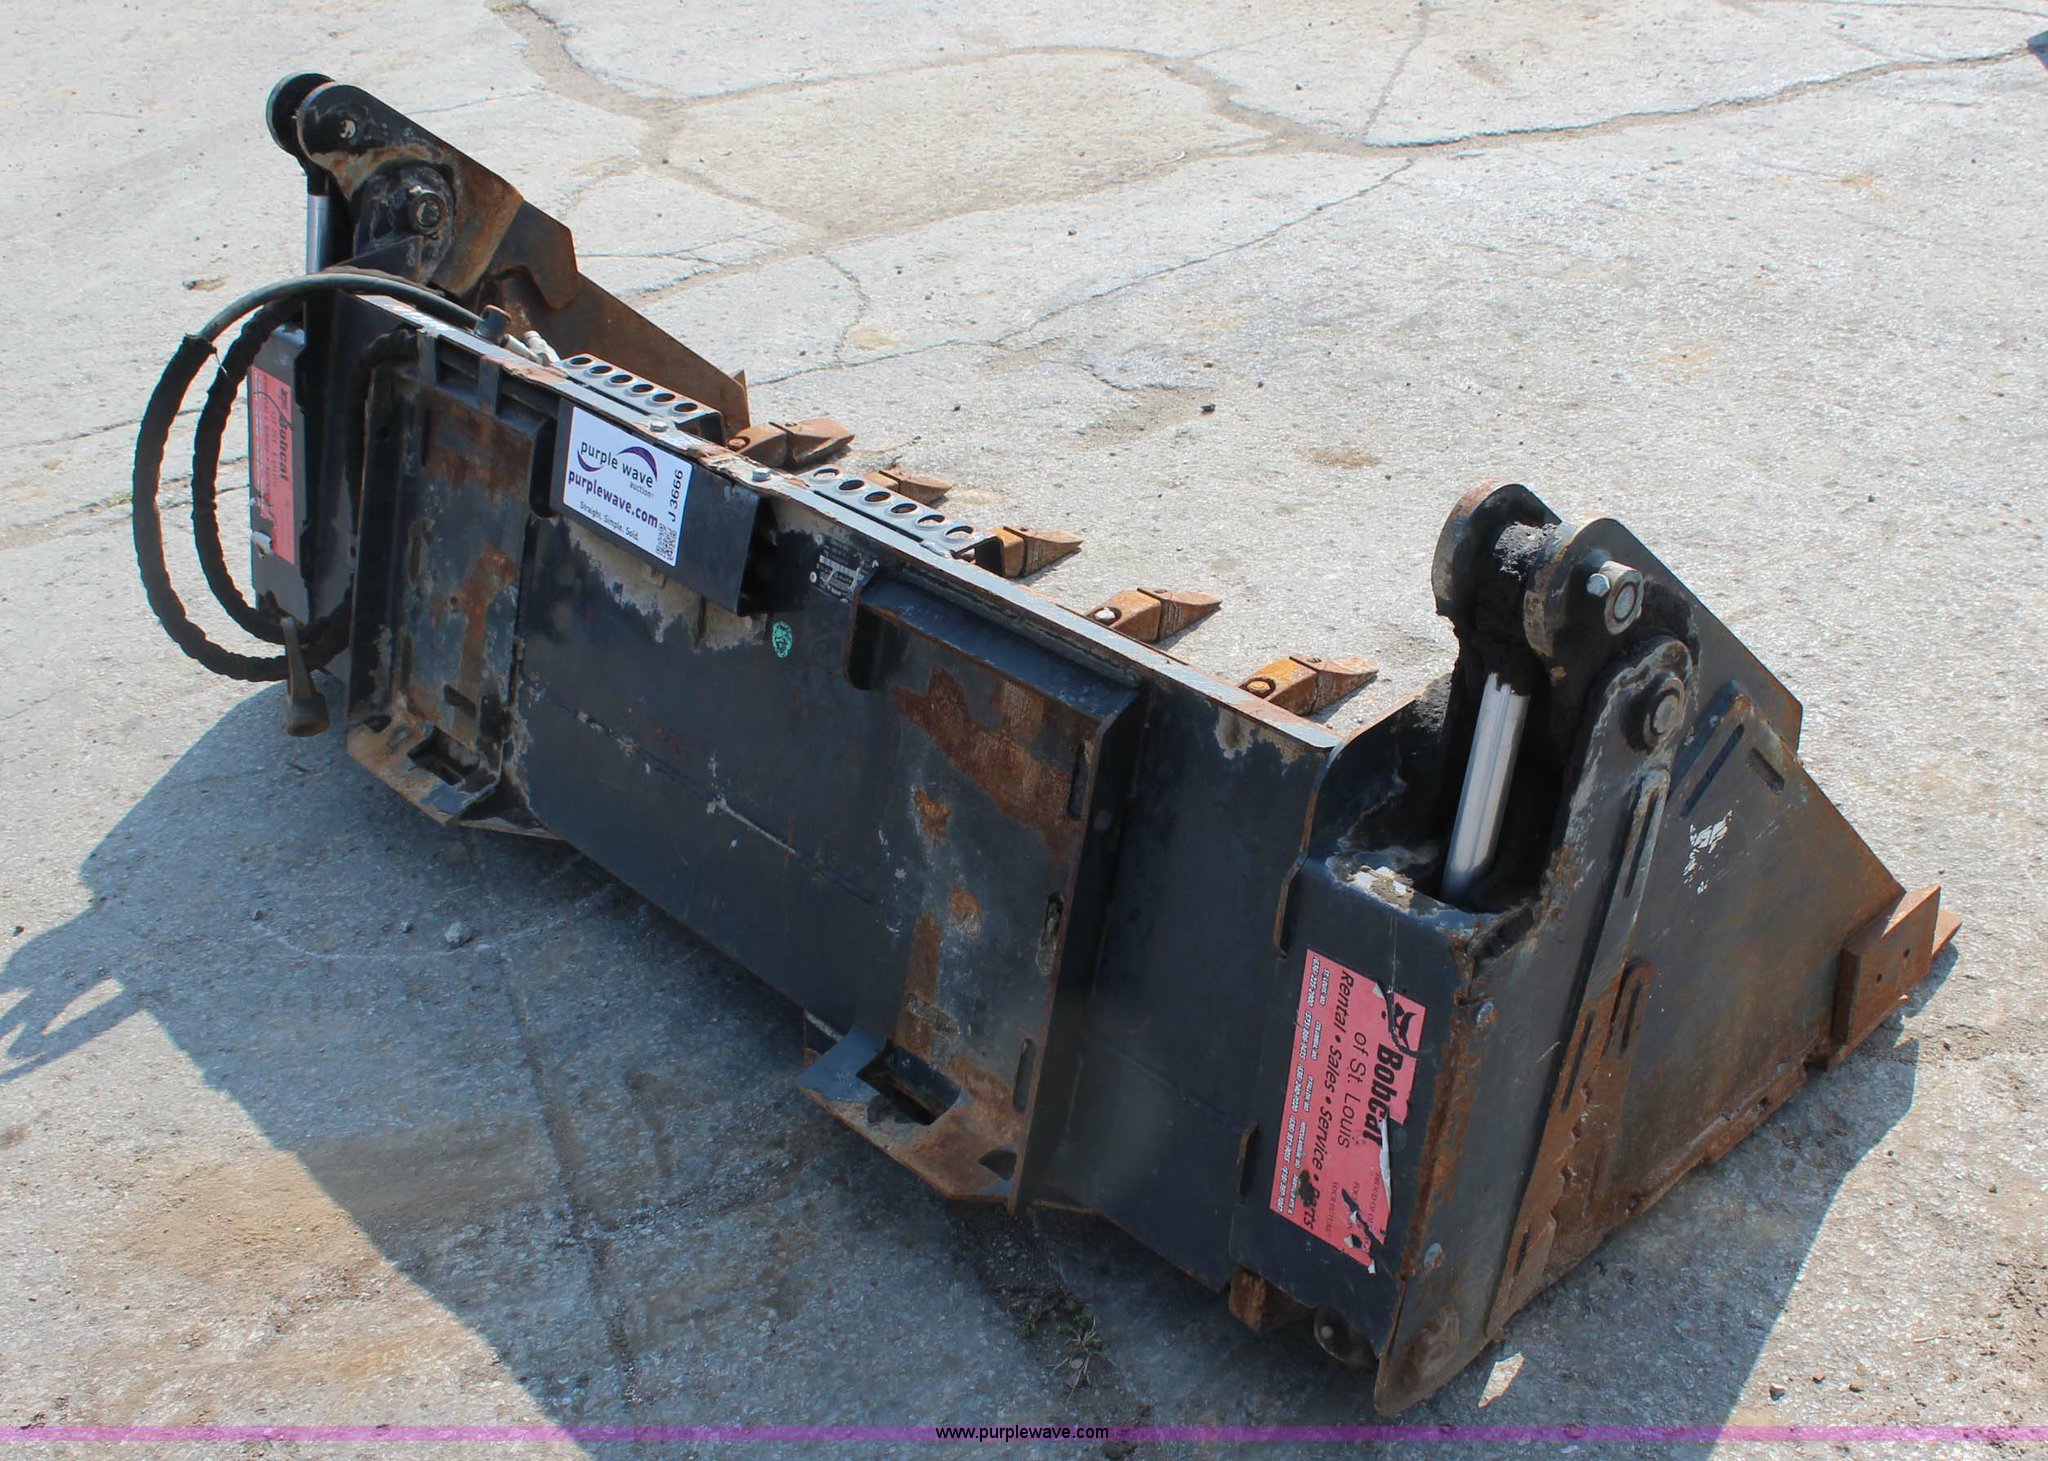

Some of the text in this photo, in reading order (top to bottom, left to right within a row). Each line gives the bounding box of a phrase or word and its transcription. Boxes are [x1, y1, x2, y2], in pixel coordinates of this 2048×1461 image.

[581, 441, 653, 488] purple wave
[568, 470, 658, 529] purplewave.com
[668, 470, 683, 523] J 3666
[625, 527, 639, 541] Sold.
[1334, 971, 1354, 1033] Rental
[1324, 1045, 1342, 1092] Sales
[1338, 1032, 1369, 1148] of St. Louis
[1362, 1043, 1404, 1147] Bobcat
[1312, 1106, 1332, 1170] Service
